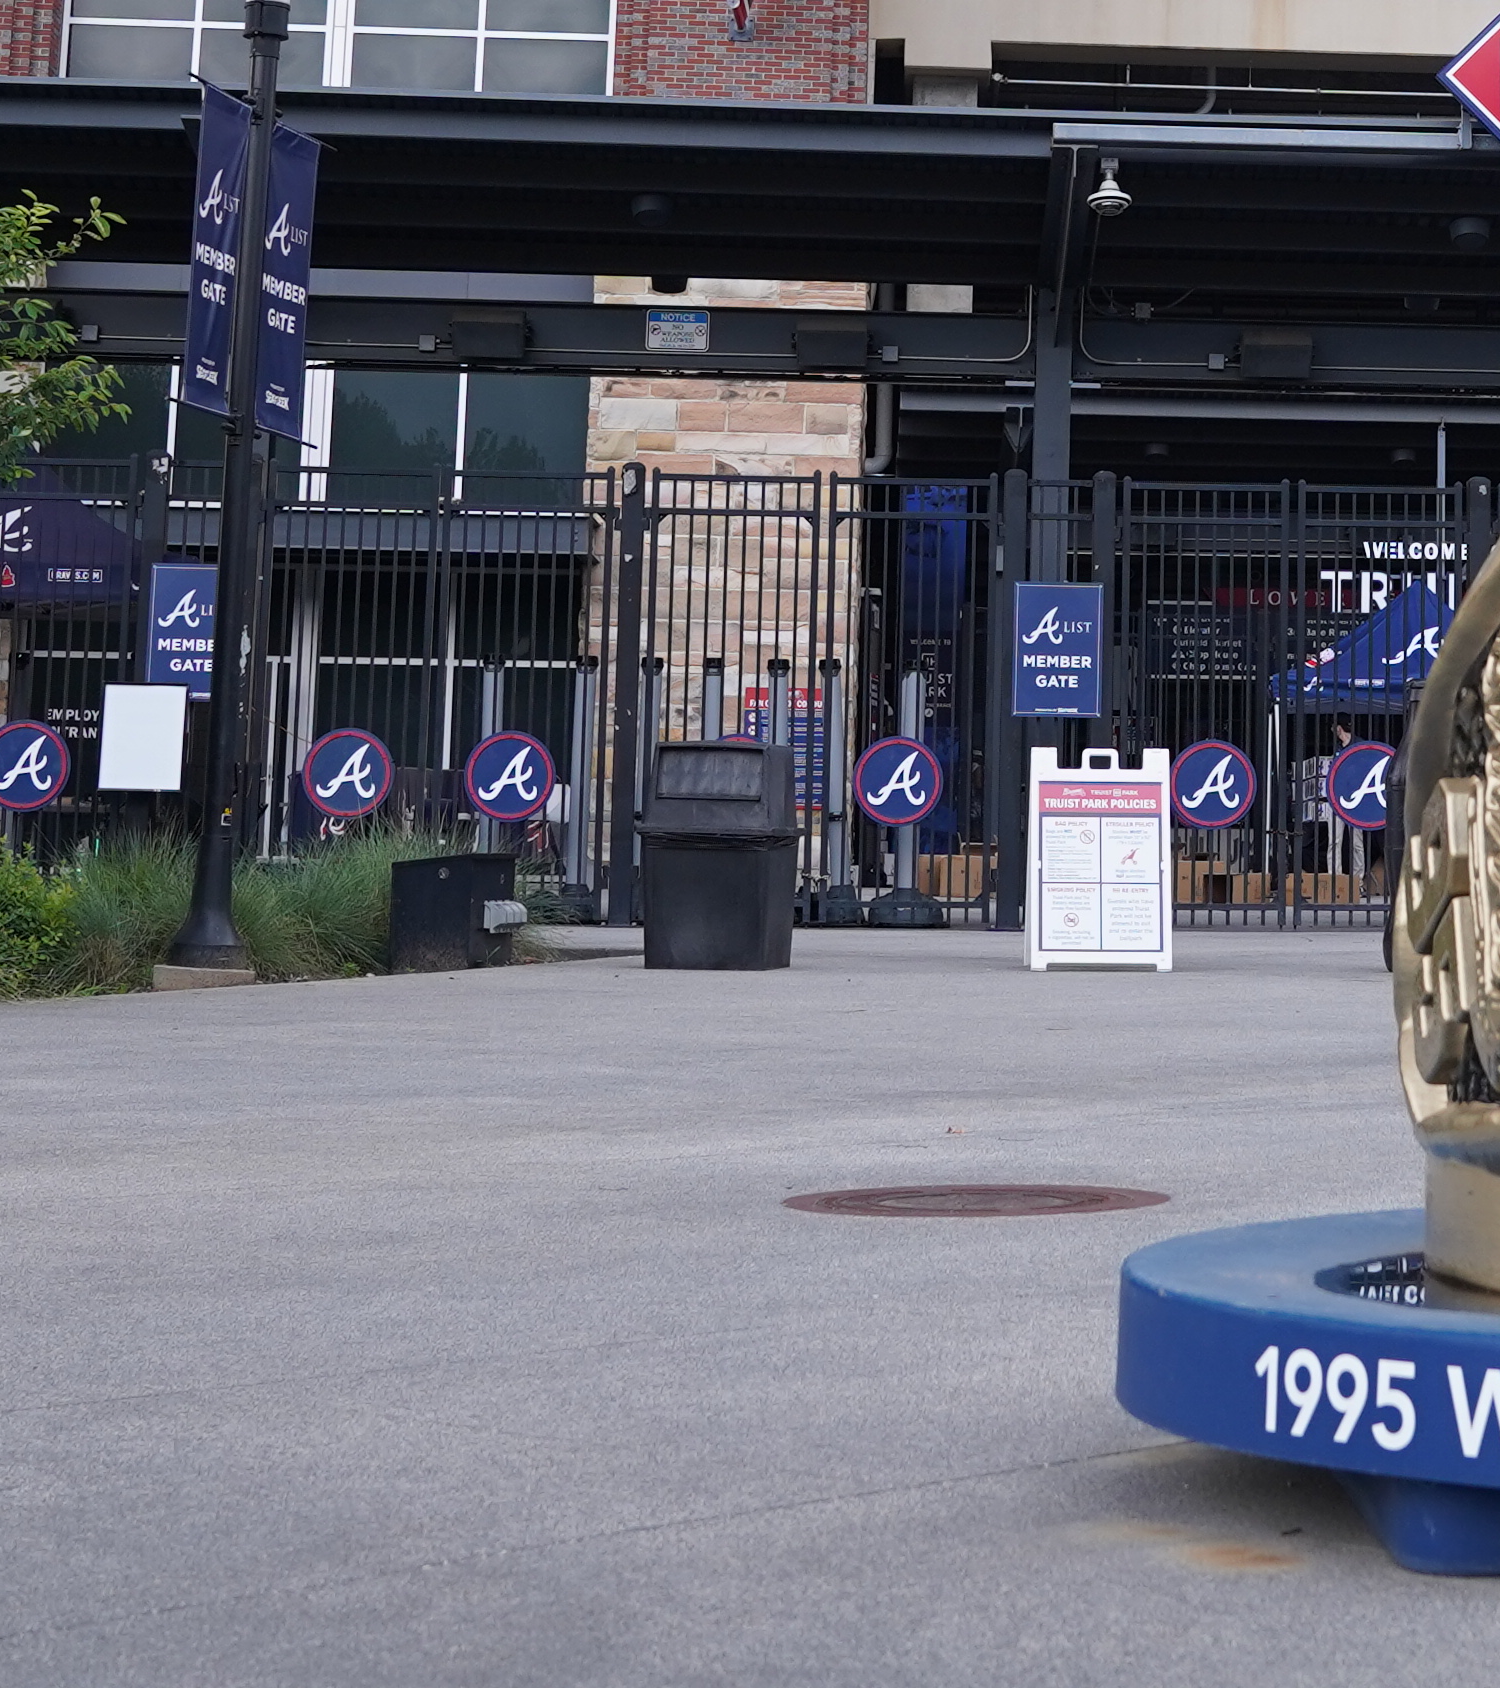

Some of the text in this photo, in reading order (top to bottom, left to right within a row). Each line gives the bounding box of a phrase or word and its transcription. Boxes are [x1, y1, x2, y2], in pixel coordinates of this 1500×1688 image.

[223, 192, 241, 214] LST
[291, 226, 308, 247] LIST
[196, 242, 236, 277] MEMBER
[201, 278, 227, 306] GATE
[263, 272, 306, 307] MEMBER
[267, 308, 297, 334] GATE
[660, 313, 696, 322] NOTICE
[1363, 541, 1468, 560] WELCOME
[1063, 621, 1093, 633] LIST
[157, 638, 214, 652] MEMBE
[170, 659, 213, 672] GATE
[1023, 655, 1092, 669] MEMBER
[1035, 674, 1079, 688] GATE
[48, 708, 100, 722] EMPLOY
[1044, 798, 1157, 809] TRUIST PARK POLICIES
[1252, 1345, 1420, 1453] 1995
